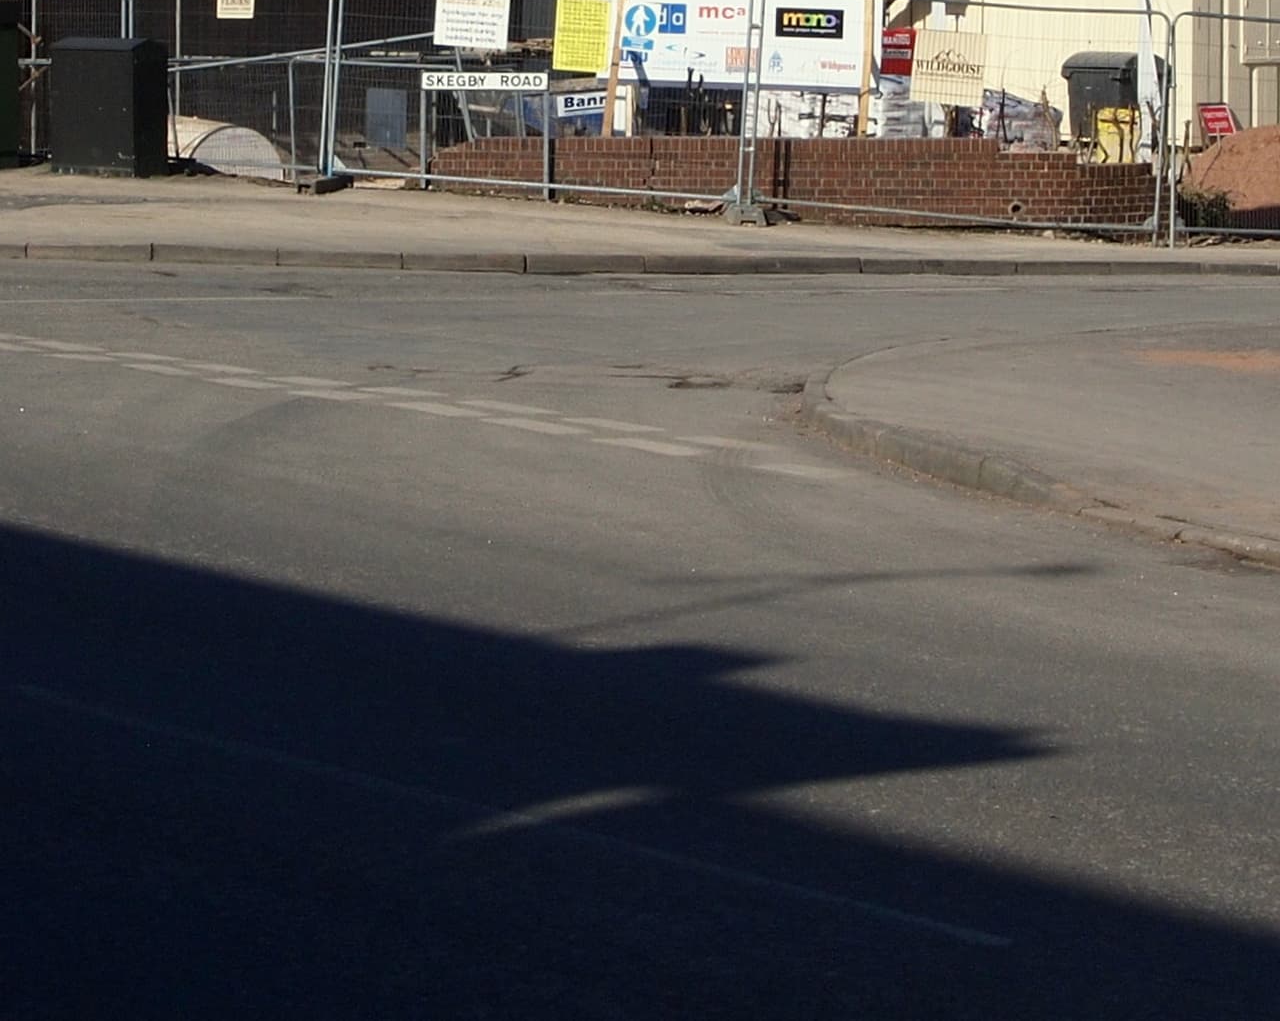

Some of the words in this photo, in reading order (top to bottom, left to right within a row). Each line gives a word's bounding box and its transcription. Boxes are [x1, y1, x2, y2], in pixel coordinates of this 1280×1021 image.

[783, 12, 837, 28] mono
[425, 74, 487, 87] SKEGBY
[500, 74, 543, 87] ROAD
